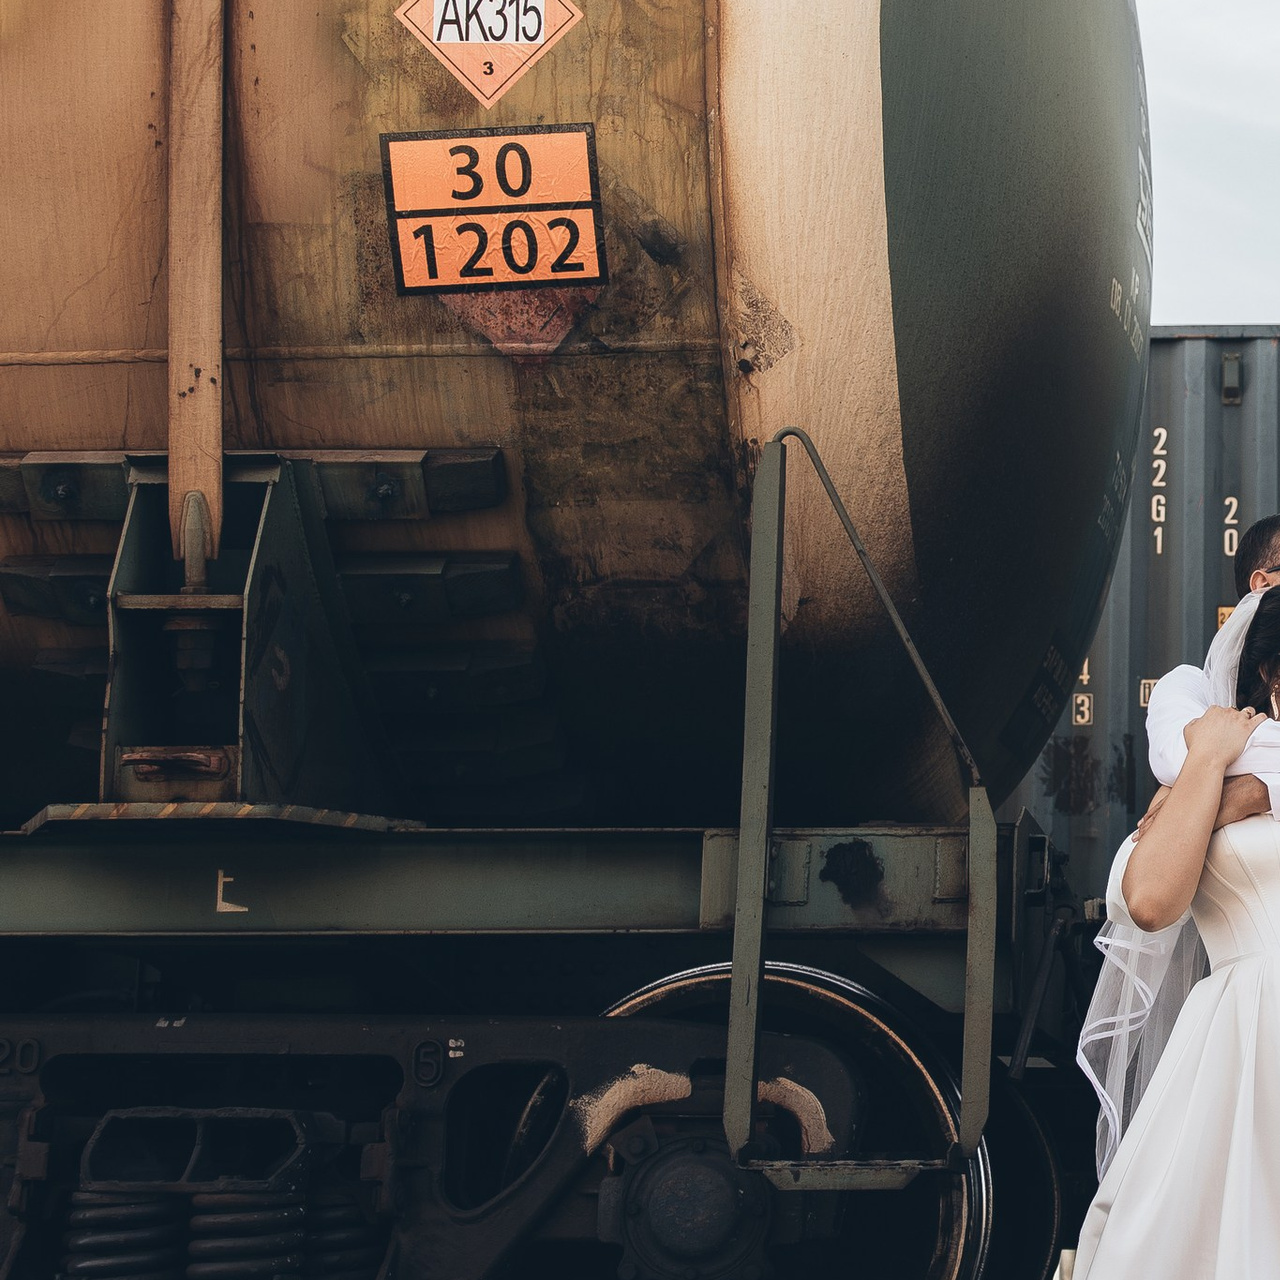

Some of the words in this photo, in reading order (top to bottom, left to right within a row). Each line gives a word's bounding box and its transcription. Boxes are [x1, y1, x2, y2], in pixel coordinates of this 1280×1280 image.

[481, 60, 495, 77] 3
[450, 142, 534, 202] 30
[411, 216, 588, 280] 1202
